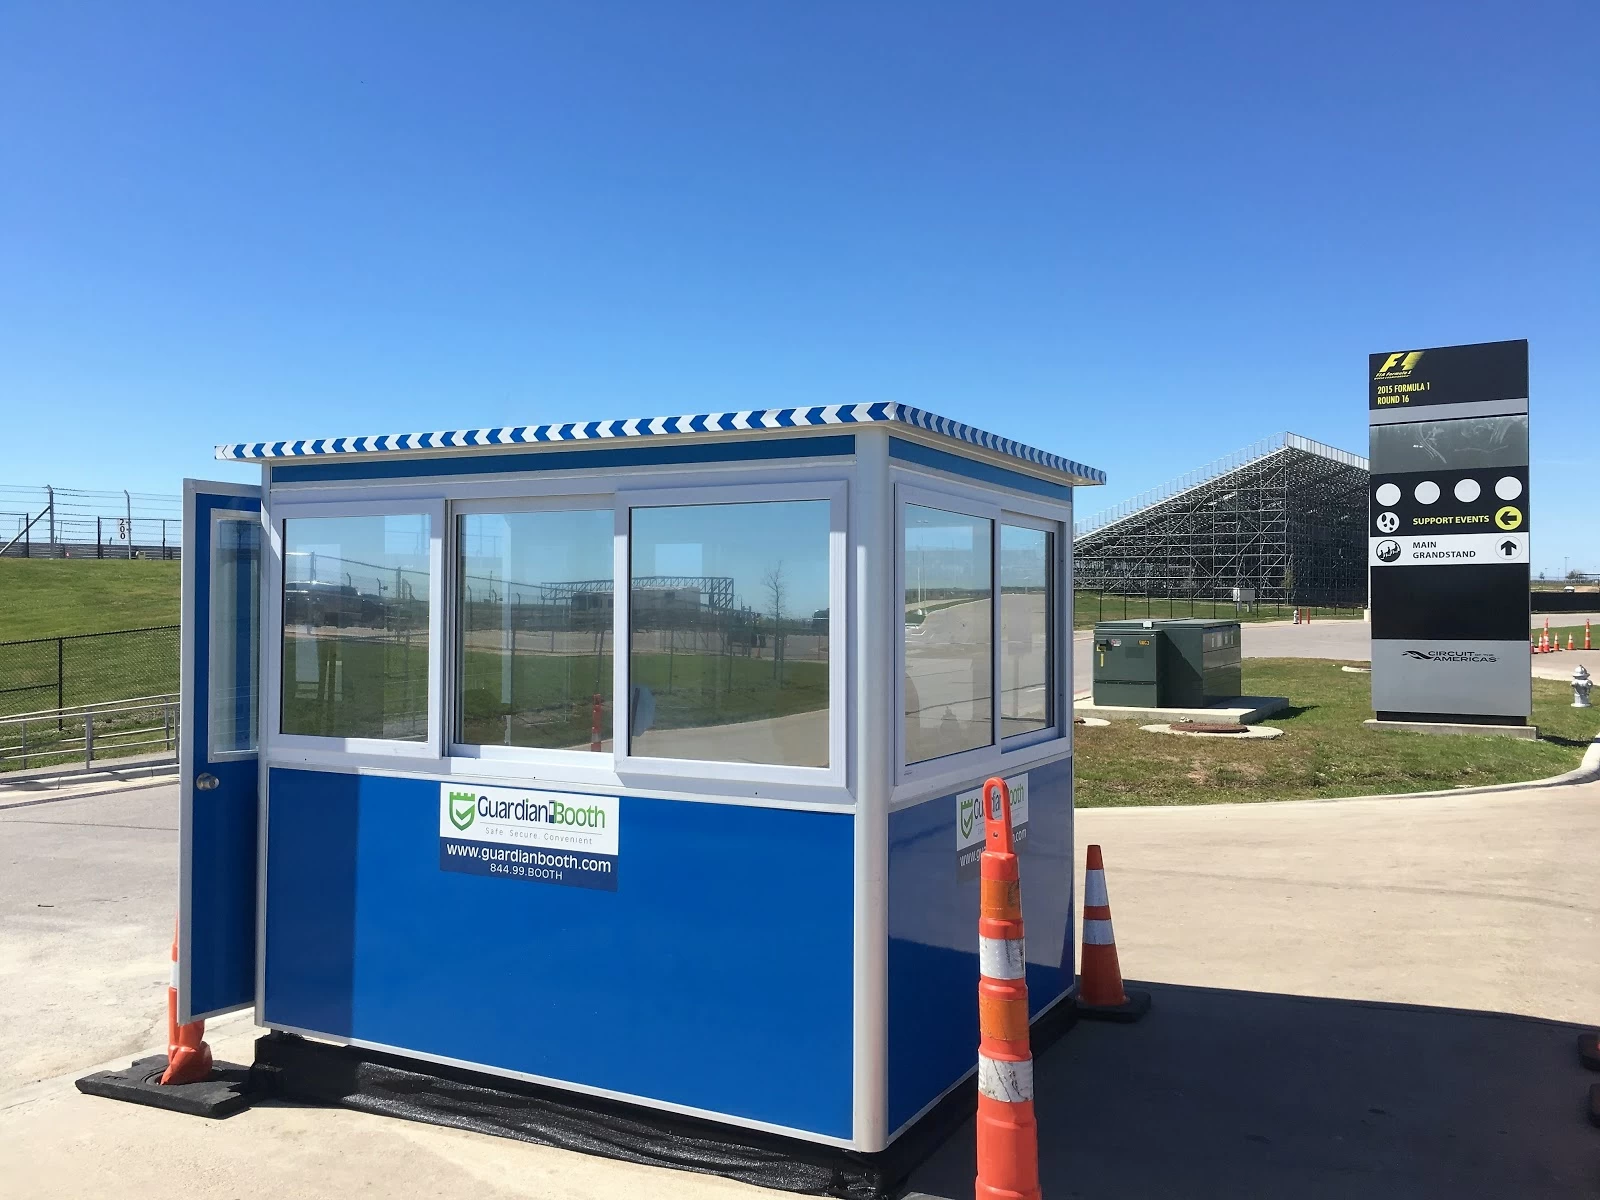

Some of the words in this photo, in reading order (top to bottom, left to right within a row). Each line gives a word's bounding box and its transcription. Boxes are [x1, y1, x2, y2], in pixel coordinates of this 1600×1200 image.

[1379, 351, 1425, 373] F1
[1377, 385, 1393, 395] 2015
[1394, 382, 1425, 393] FORMULA
[1426, 381, 1430, 391] 1
[1377, 395, 1400, 405] ROUND
[1401, 394, 1410, 403] 16
[1412, 516, 1454, 526] SUPPORT
[1455, 515, 1490, 524] EVENTS
[1412, 541, 1437, 549] MAIN
[1412, 550, 1476, 559] GRANDSTAND
[543, 832, 593, 845] Convenient
[446, 843, 612, 873] www.guardianbooth.com
[490, 863, 563, 880] 844.99.BOOTH
